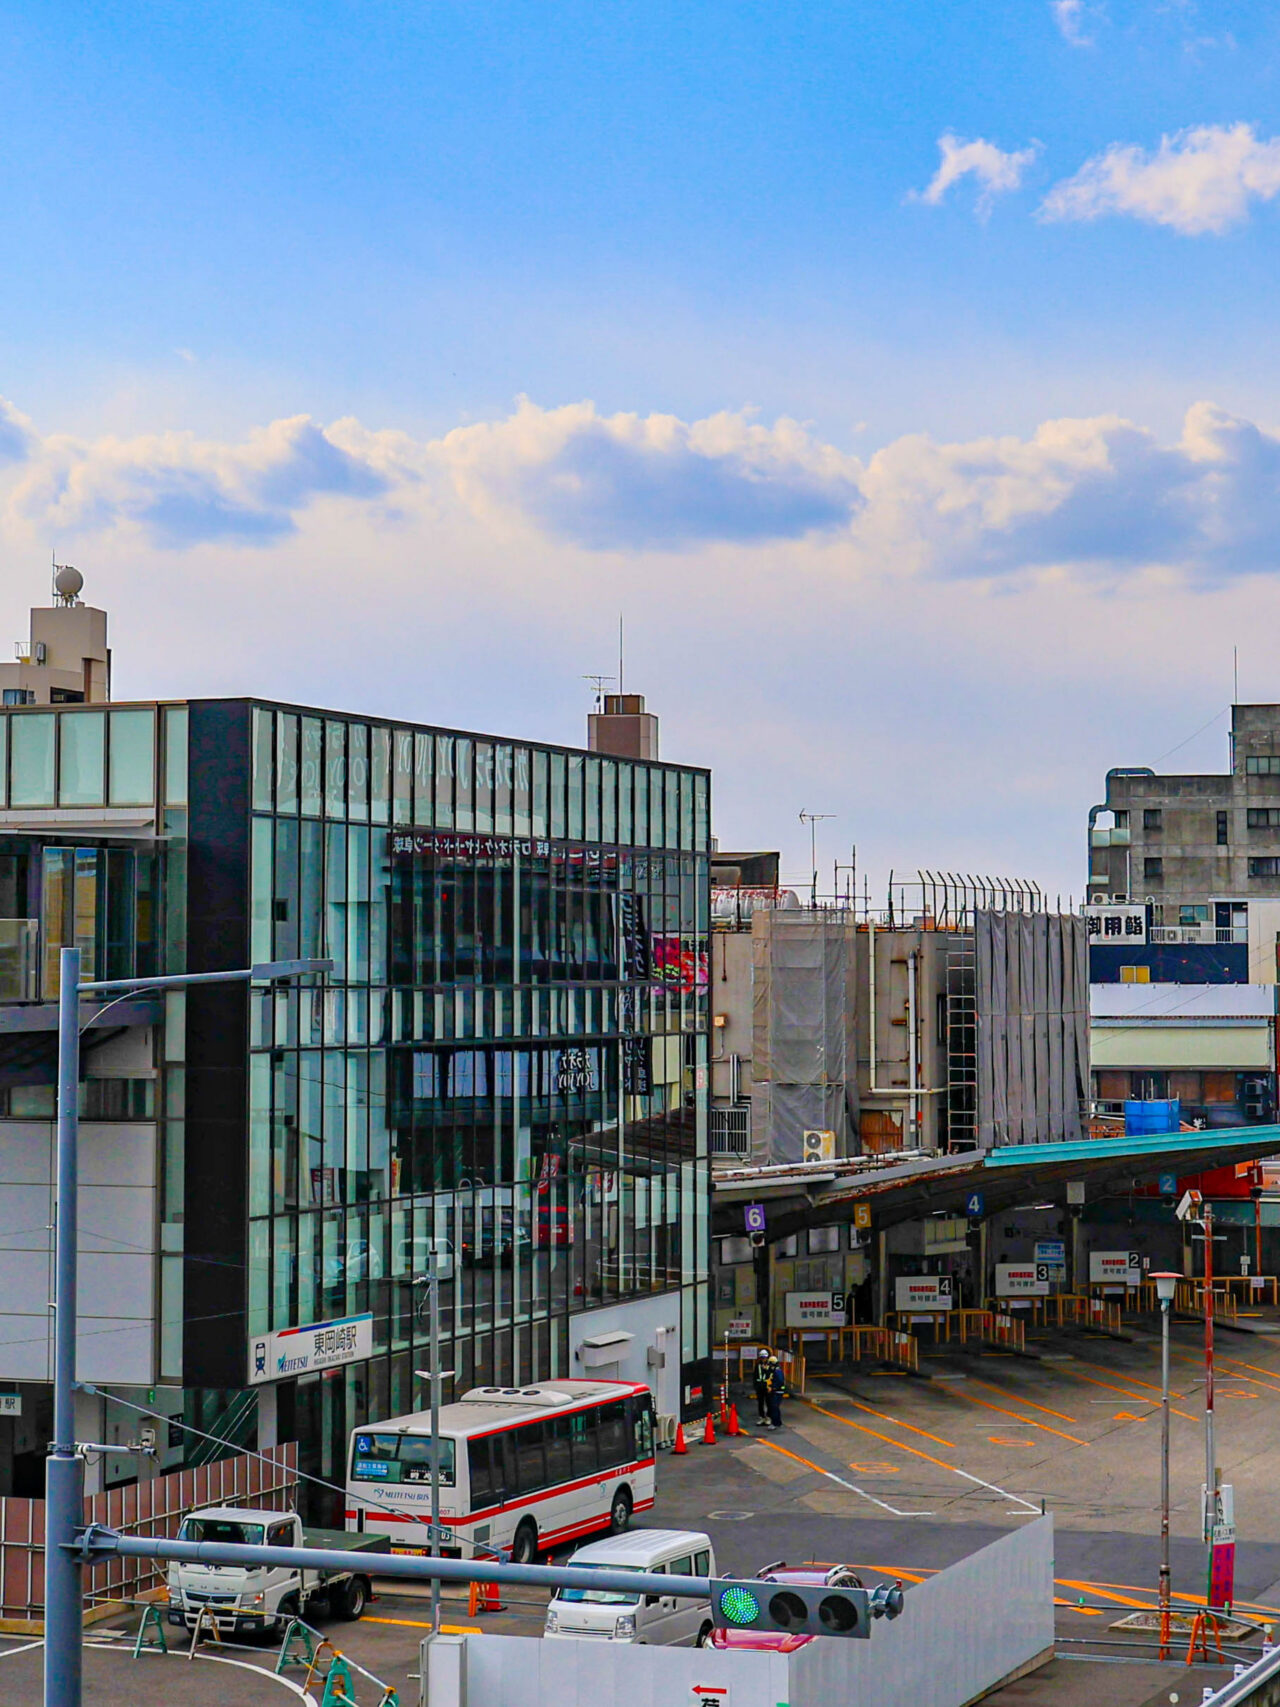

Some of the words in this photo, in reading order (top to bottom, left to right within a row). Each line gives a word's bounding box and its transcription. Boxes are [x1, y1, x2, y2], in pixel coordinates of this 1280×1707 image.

[1161, 1175, 1174, 1192] 2
[968, 1195, 980, 1212] 4
[749, 1208, 762, 1227] 6
[857, 1206, 868, 1225] 5
[1129, 1253, 1140, 1268] 2
[1037, 1265, 1048, 1280] 3
[940, 1279, 950, 1295] 4
[833, 1294, 844, 1310] 5
[314, 1325, 357, 1357] 東岡崎駅
